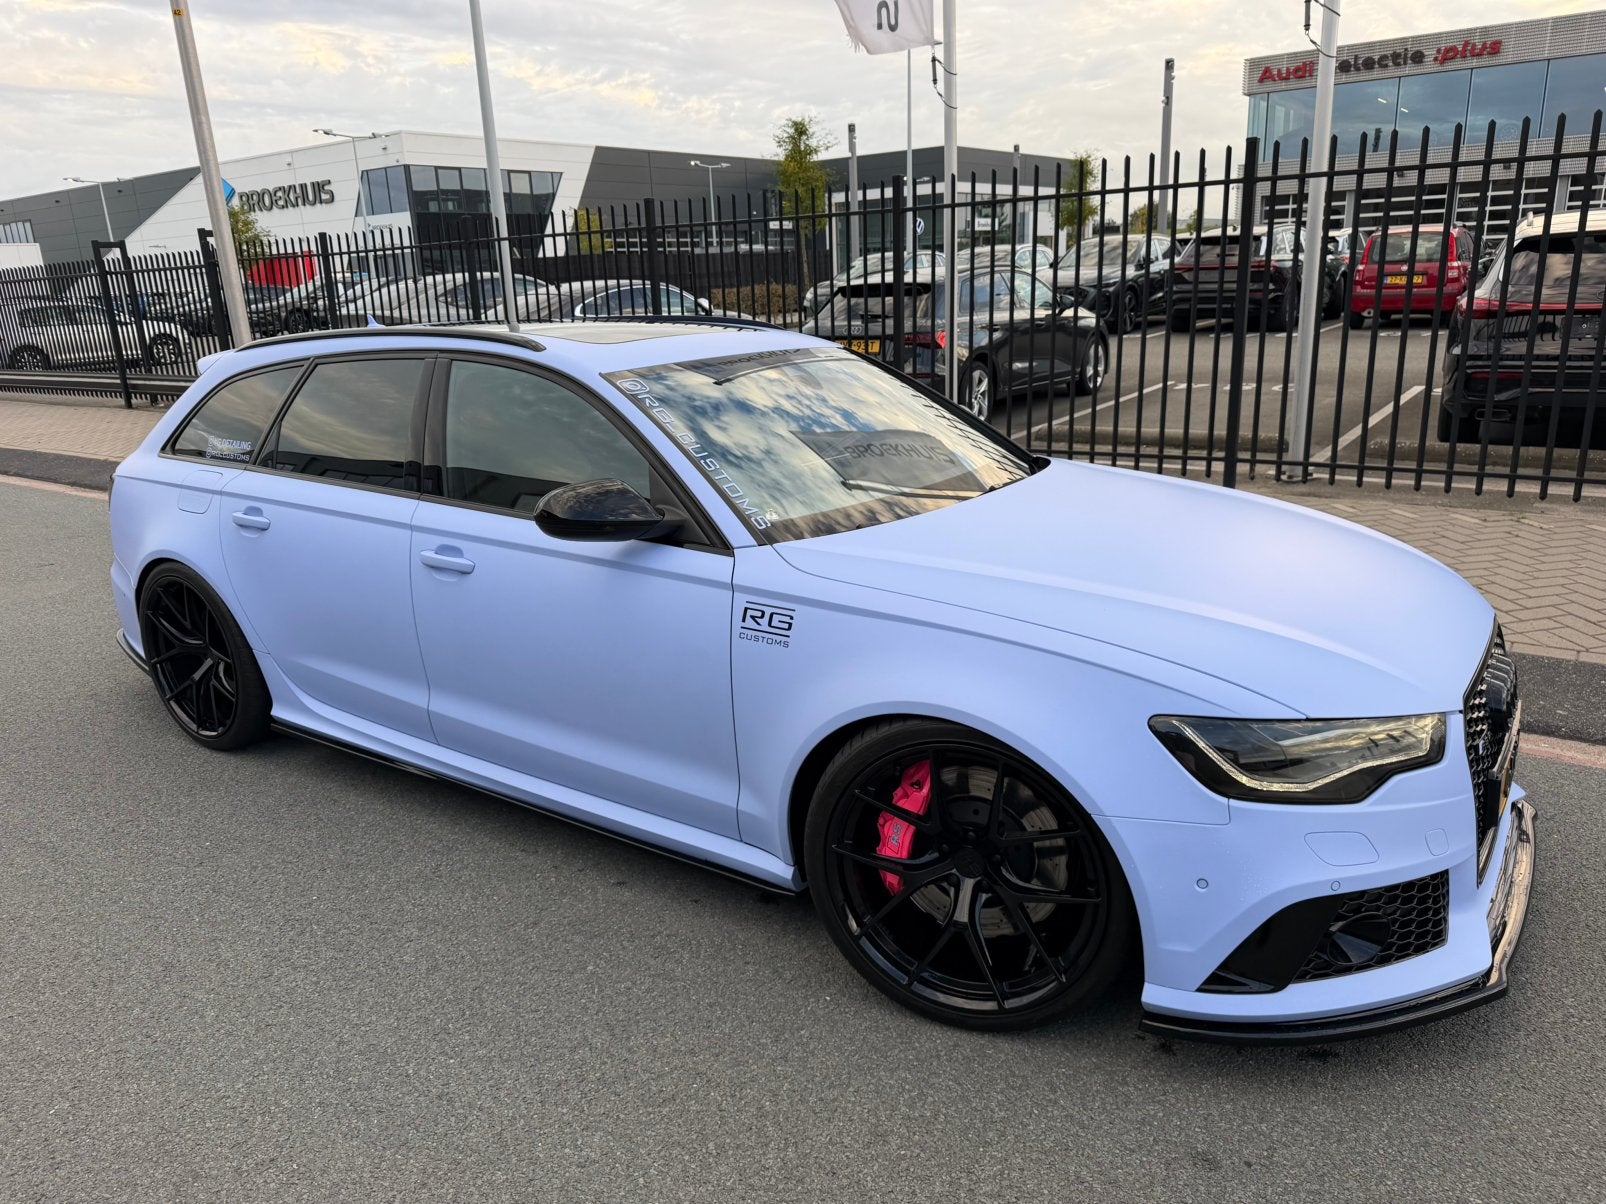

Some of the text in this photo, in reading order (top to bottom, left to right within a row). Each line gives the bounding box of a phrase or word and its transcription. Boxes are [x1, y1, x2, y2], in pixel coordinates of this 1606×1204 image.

[1257, 60, 1314, 83] Audi
[1335, 48, 1425, 73] electie
[238, 179, 335, 214] BROEKHUIS
[843, 443, 955, 465] BROEKHUIS
[741, 606, 795, 632] RG
[738, 632, 790, 649] CUSTOMS
